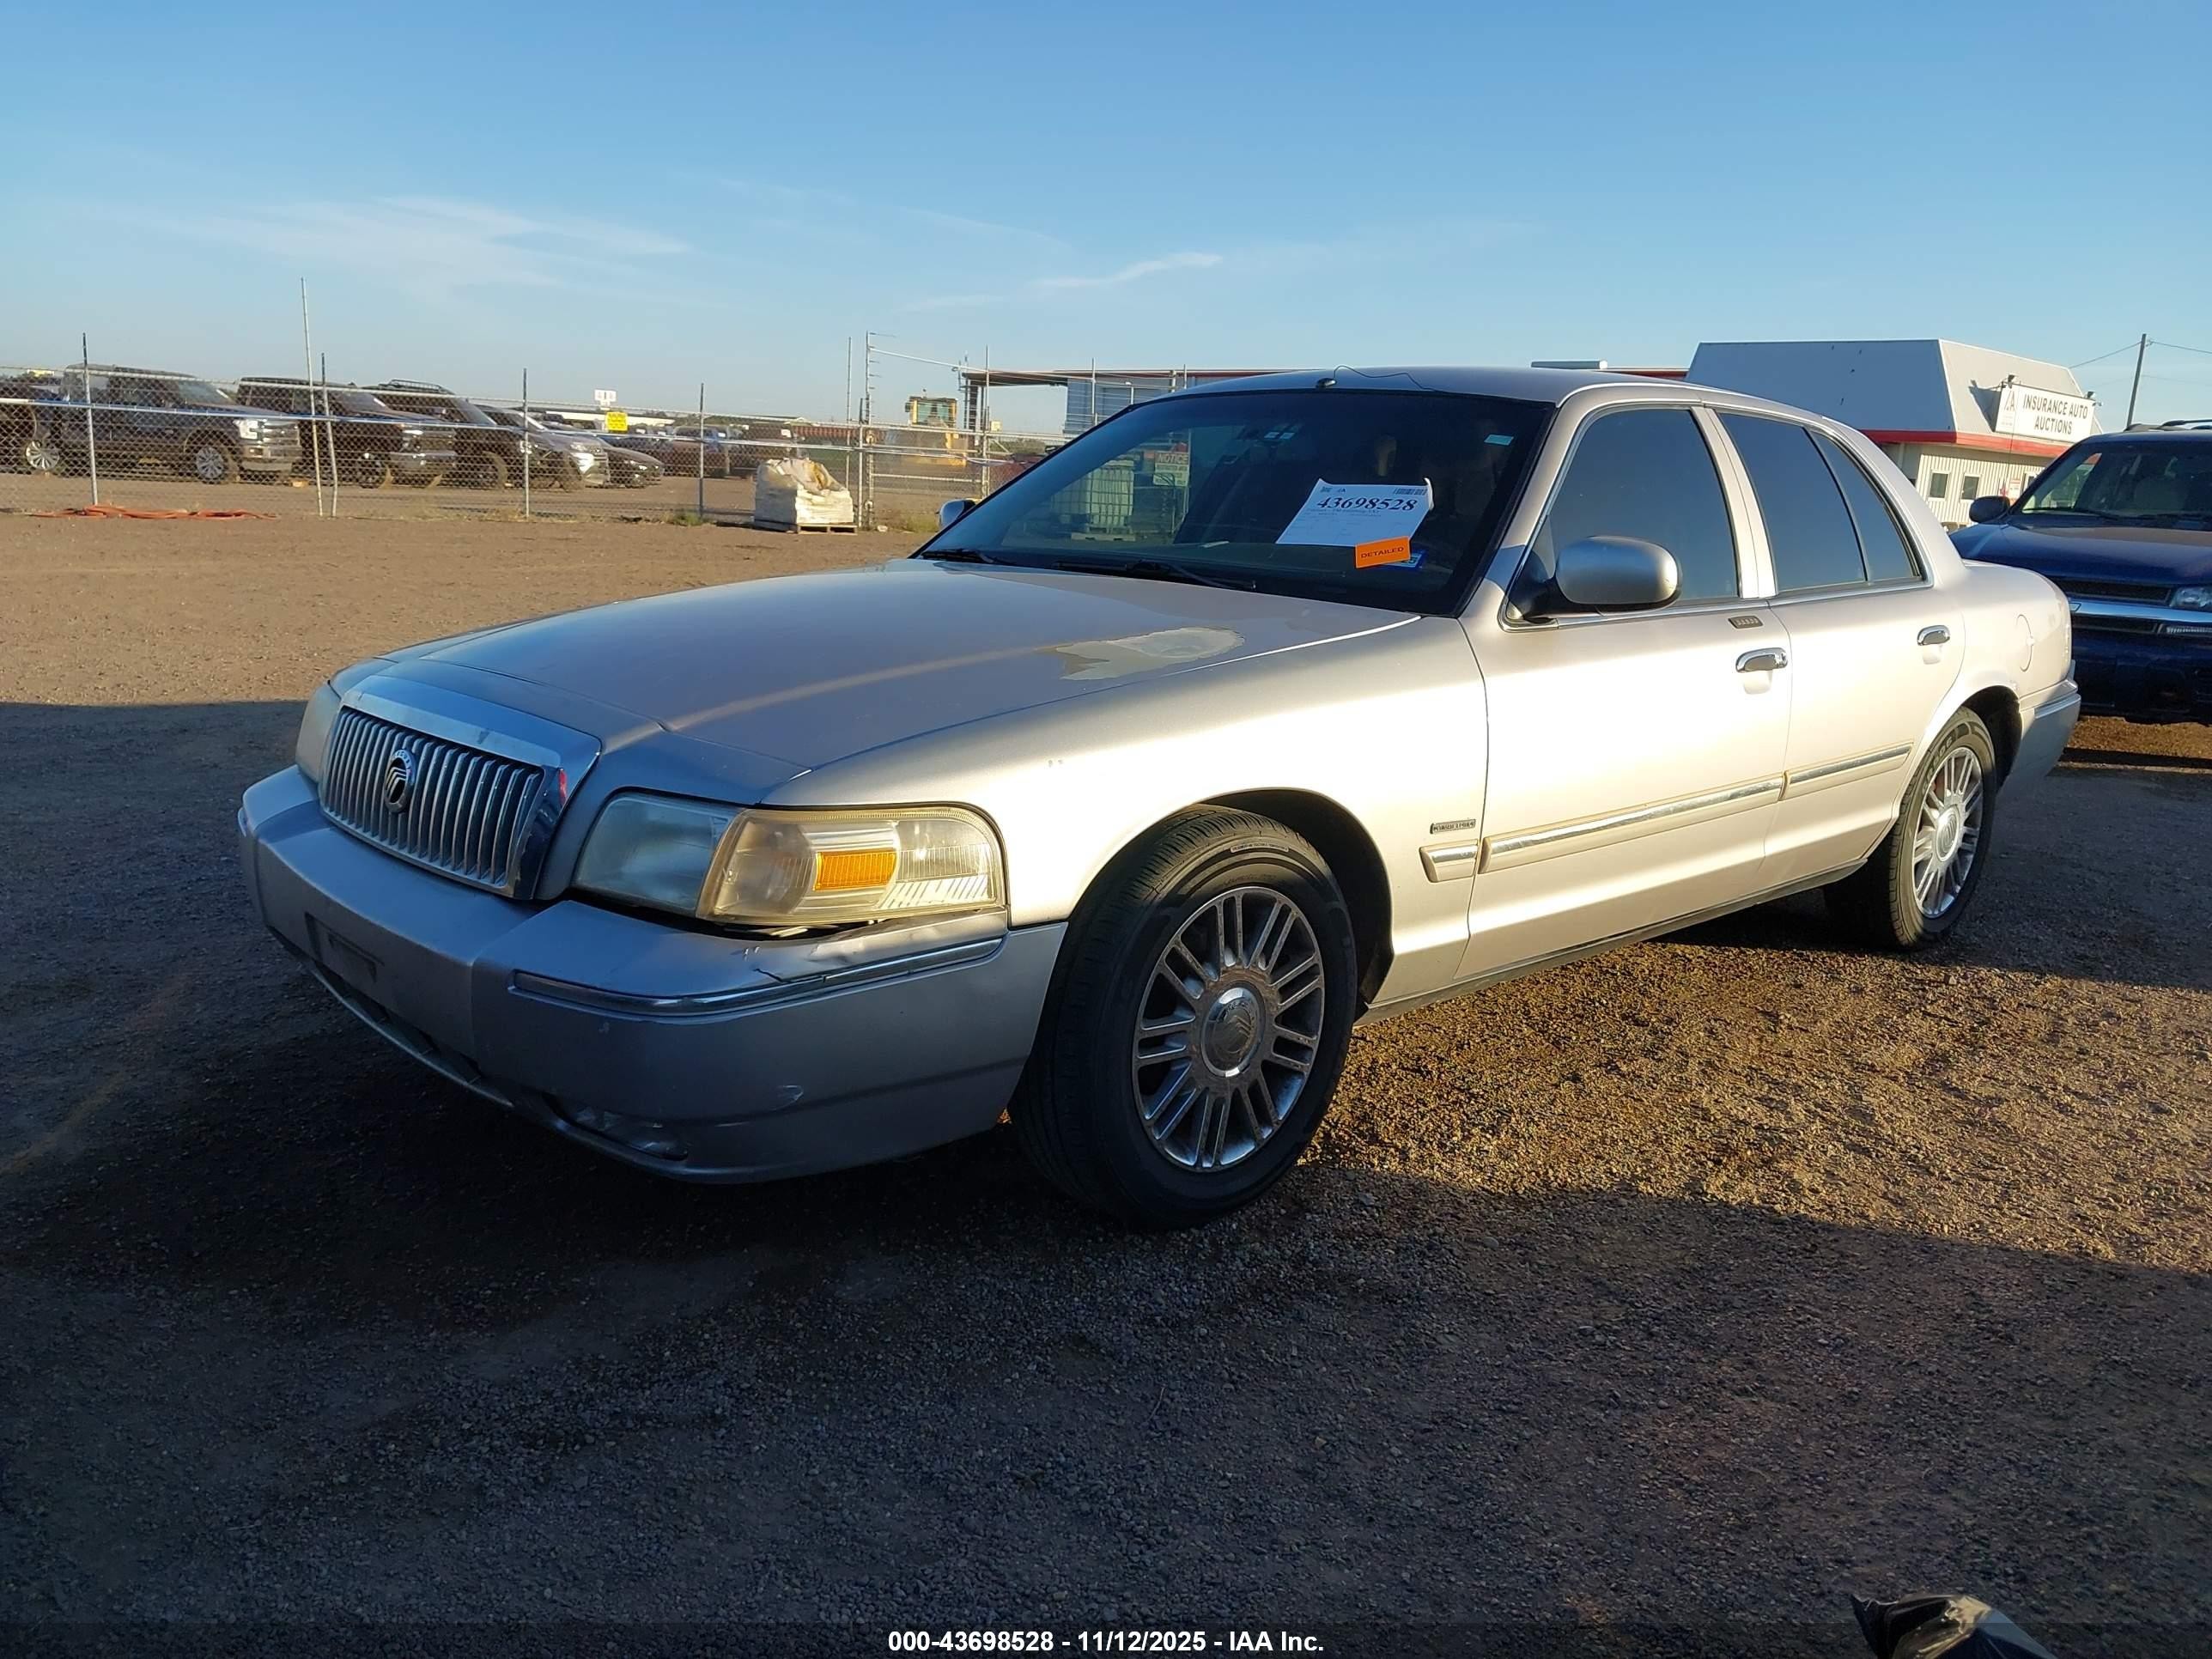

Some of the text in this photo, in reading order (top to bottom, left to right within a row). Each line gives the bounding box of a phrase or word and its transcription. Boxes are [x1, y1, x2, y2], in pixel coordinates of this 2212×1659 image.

[2023, 394, 2088, 419] INSURANCE AUTO
[2033, 416, 2073, 435] AUCTIONS
[1157, 453, 1189, 464] NOTICE
[1316, 496, 1418, 511] 43698528
[1360, 546, 1405, 559] DETAILED
